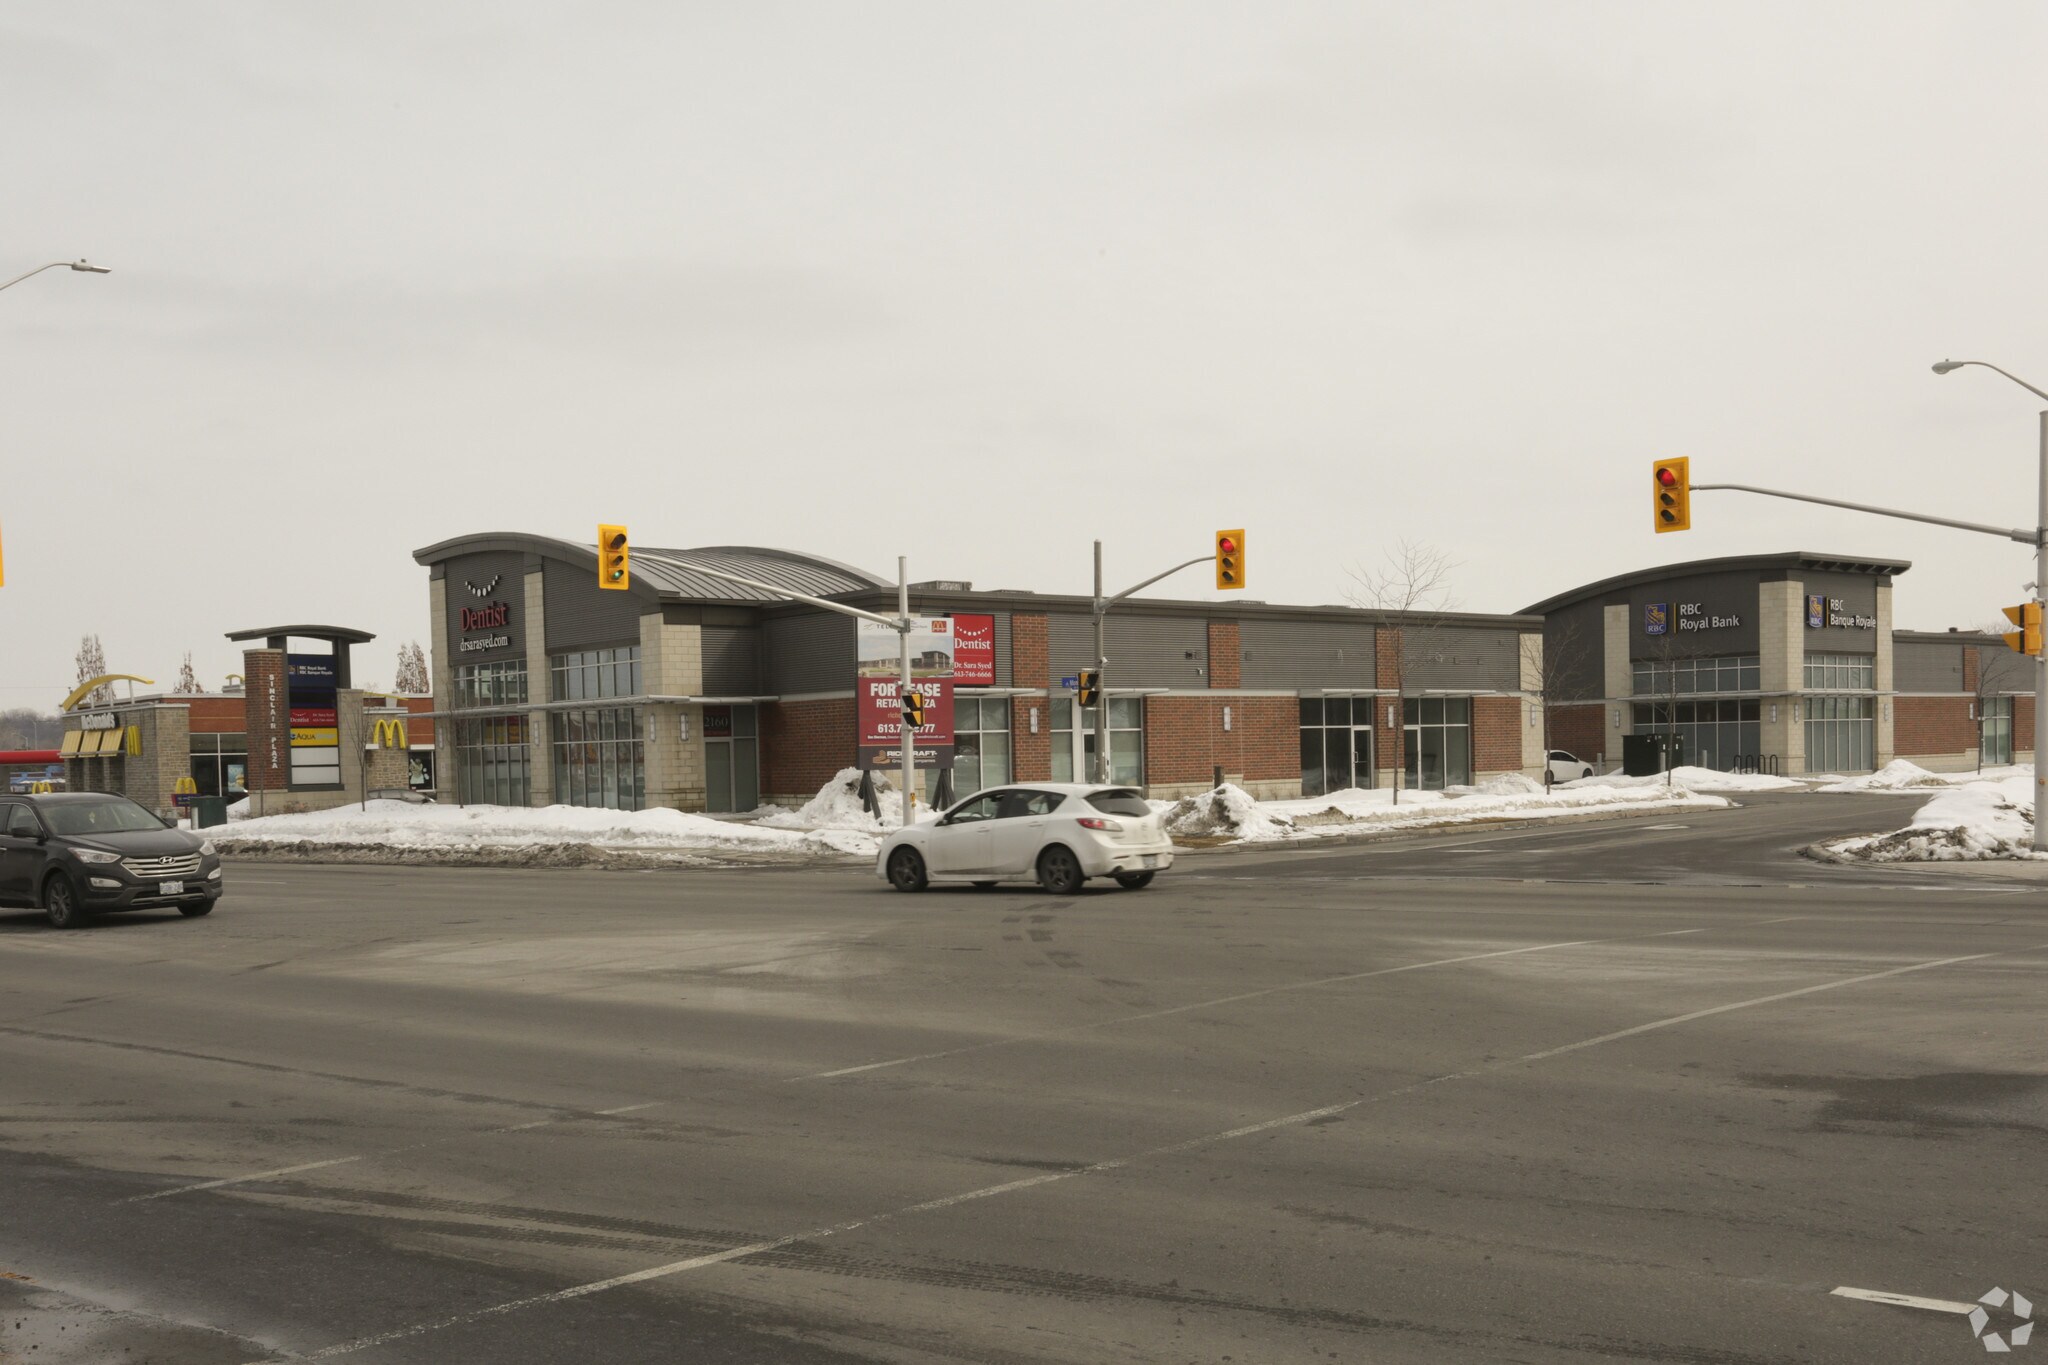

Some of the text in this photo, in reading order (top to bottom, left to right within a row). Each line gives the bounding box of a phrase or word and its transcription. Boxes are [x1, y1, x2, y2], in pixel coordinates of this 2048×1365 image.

[1680, 603, 1701, 615] RBC
[1830, 599, 1844, 611] RBC
[460, 602, 507, 632] Dentist
[1680, 615, 1740, 632] Royal Bank
[1830, 614, 1877, 629] Banque Royale
[460, 634, 508, 652] drsarasyed.com
[954, 638, 991, 650] Dentist
[977, 662, 992, 671] Syed
[870, 683, 897, 697] FOR
[269, 674, 277, 729] SINCLAIR
[704, 717, 729, 728] 2160
